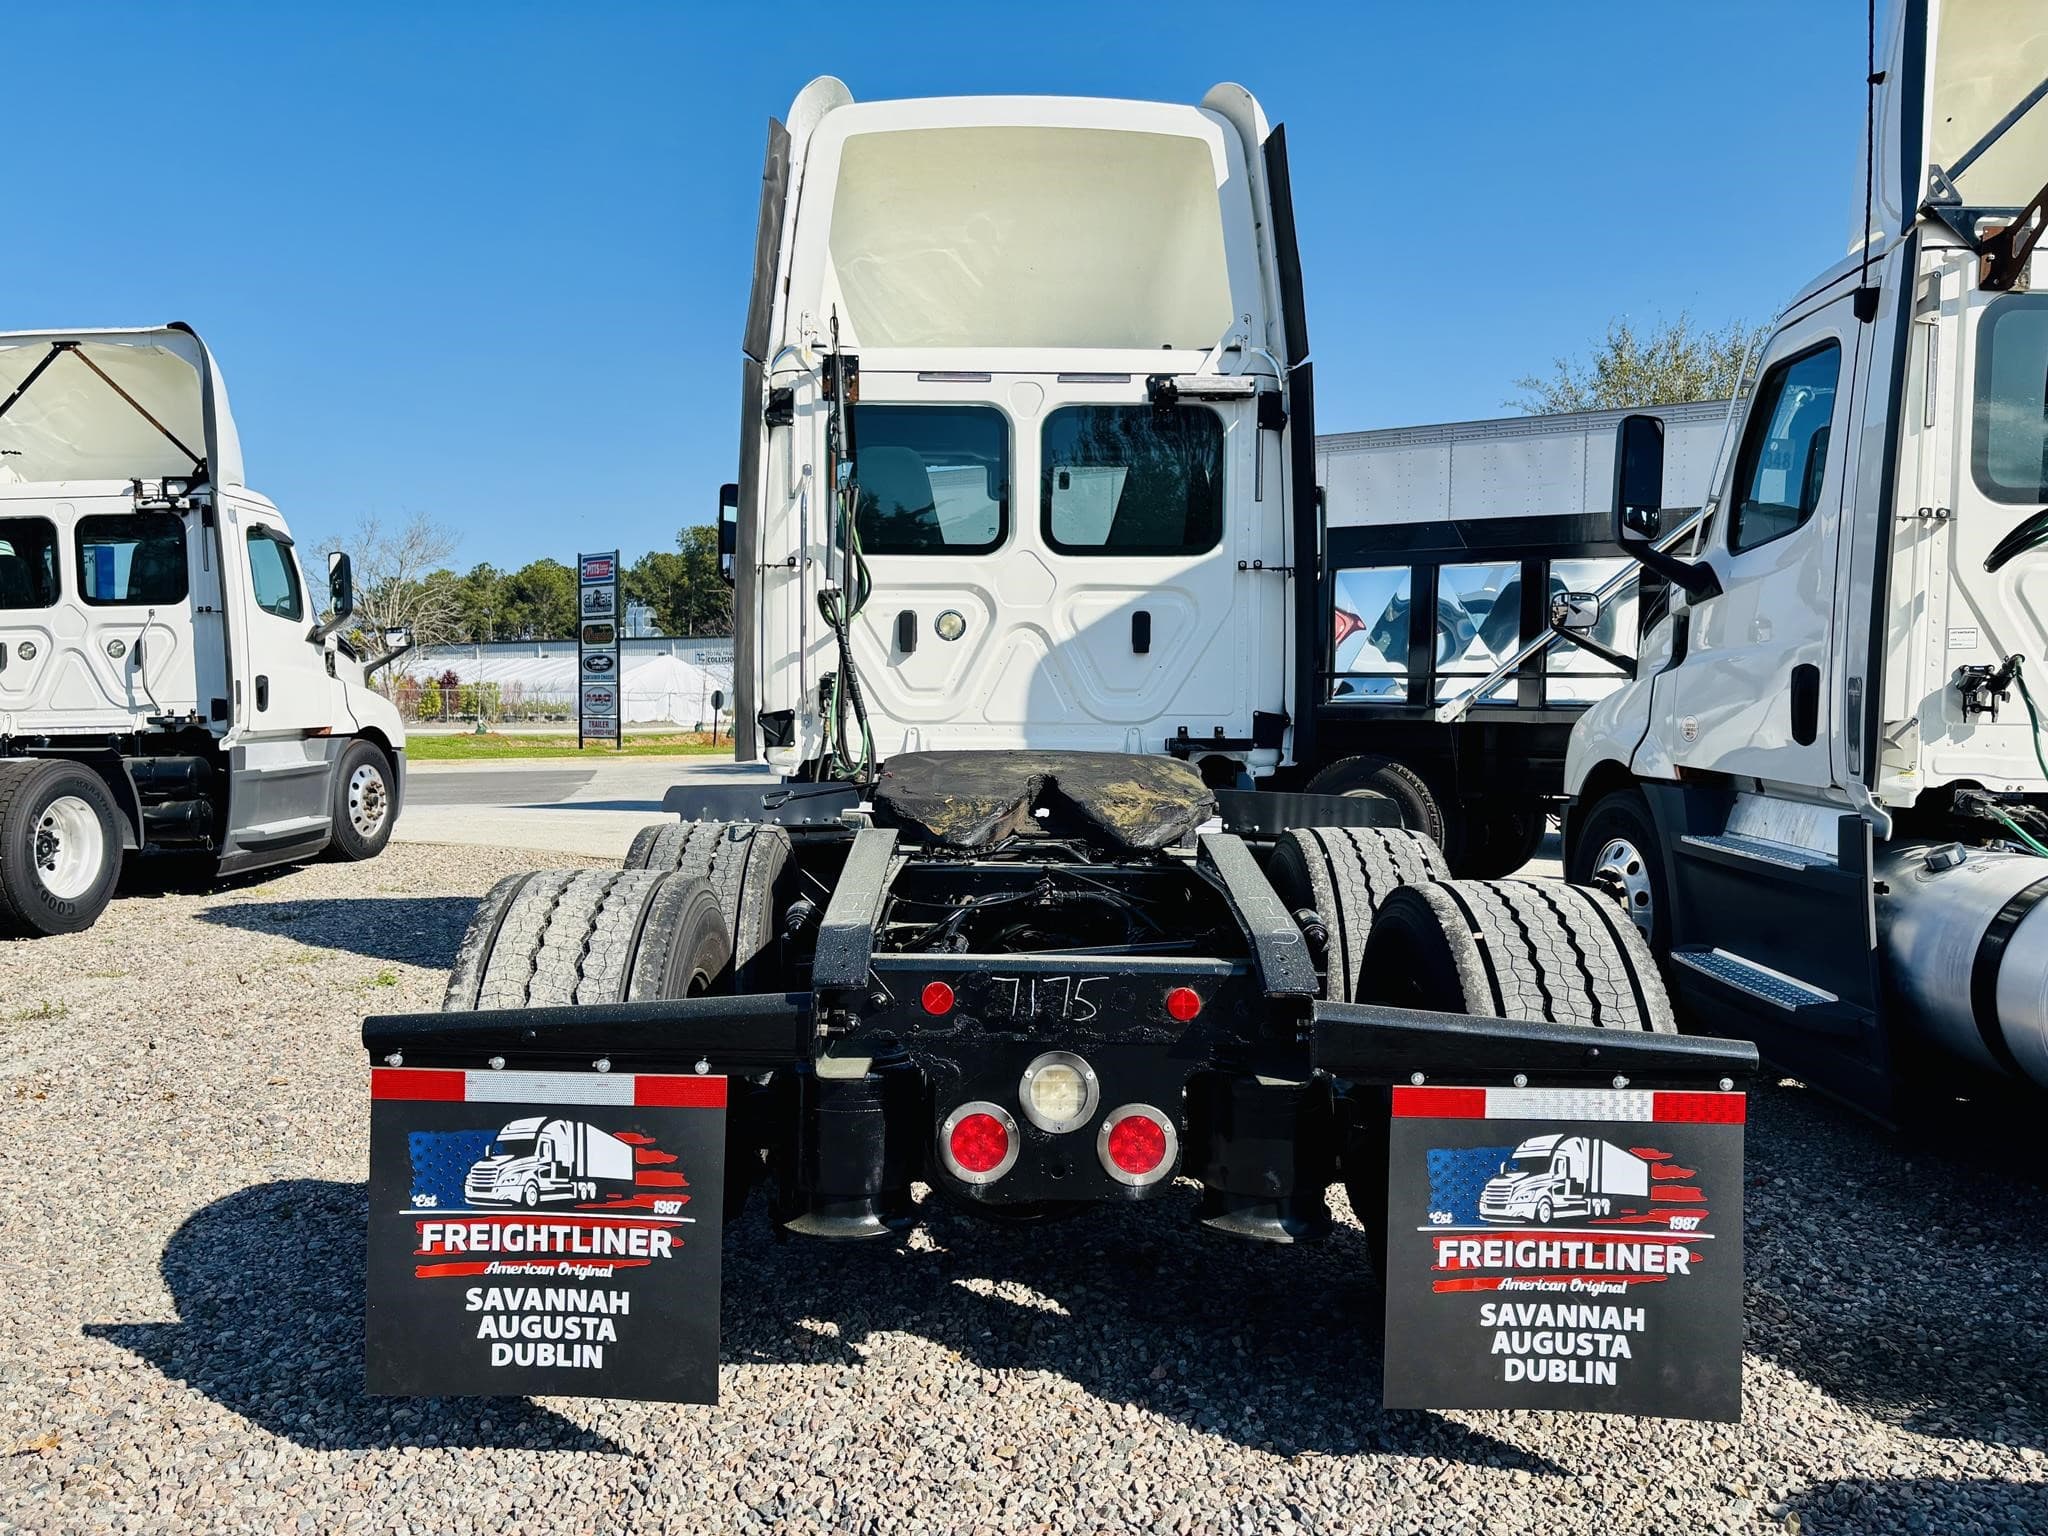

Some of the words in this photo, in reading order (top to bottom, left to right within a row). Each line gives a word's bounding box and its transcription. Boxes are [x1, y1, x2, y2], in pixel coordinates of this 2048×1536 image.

[589, 720, 609, 728] TRAILER
[992, 976, 1110, 1021] 7175
[411, 1193, 438, 1208] Est
[652, 1200, 683, 1215] 1987
[1428, 1211, 1453, 1225] Est
[1668, 1216, 1700, 1231] 1987
[421, 1222, 673, 1259] FREIGHTLINER
[483, 1261, 555, 1277] American
[557, 1262, 614, 1281] Original
[1437, 1239, 1691, 1276] FREIGHTLINER
[465, 1286, 631, 1316] SAVANNAH
[1497, 1277, 1567, 1293] American
[1569, 1278, 1628, 1298] Original
[476, 1315, 618, 1343] AUGUSTA
[1479, 1303, 1646, 1332] SAVANNAH
[490, 1342, 604, 1369] DUBLIN
[1490, 1331, 1633, 1360] AUGUSTA
[1504, 1358, 1618, 1386] DUBLIN
